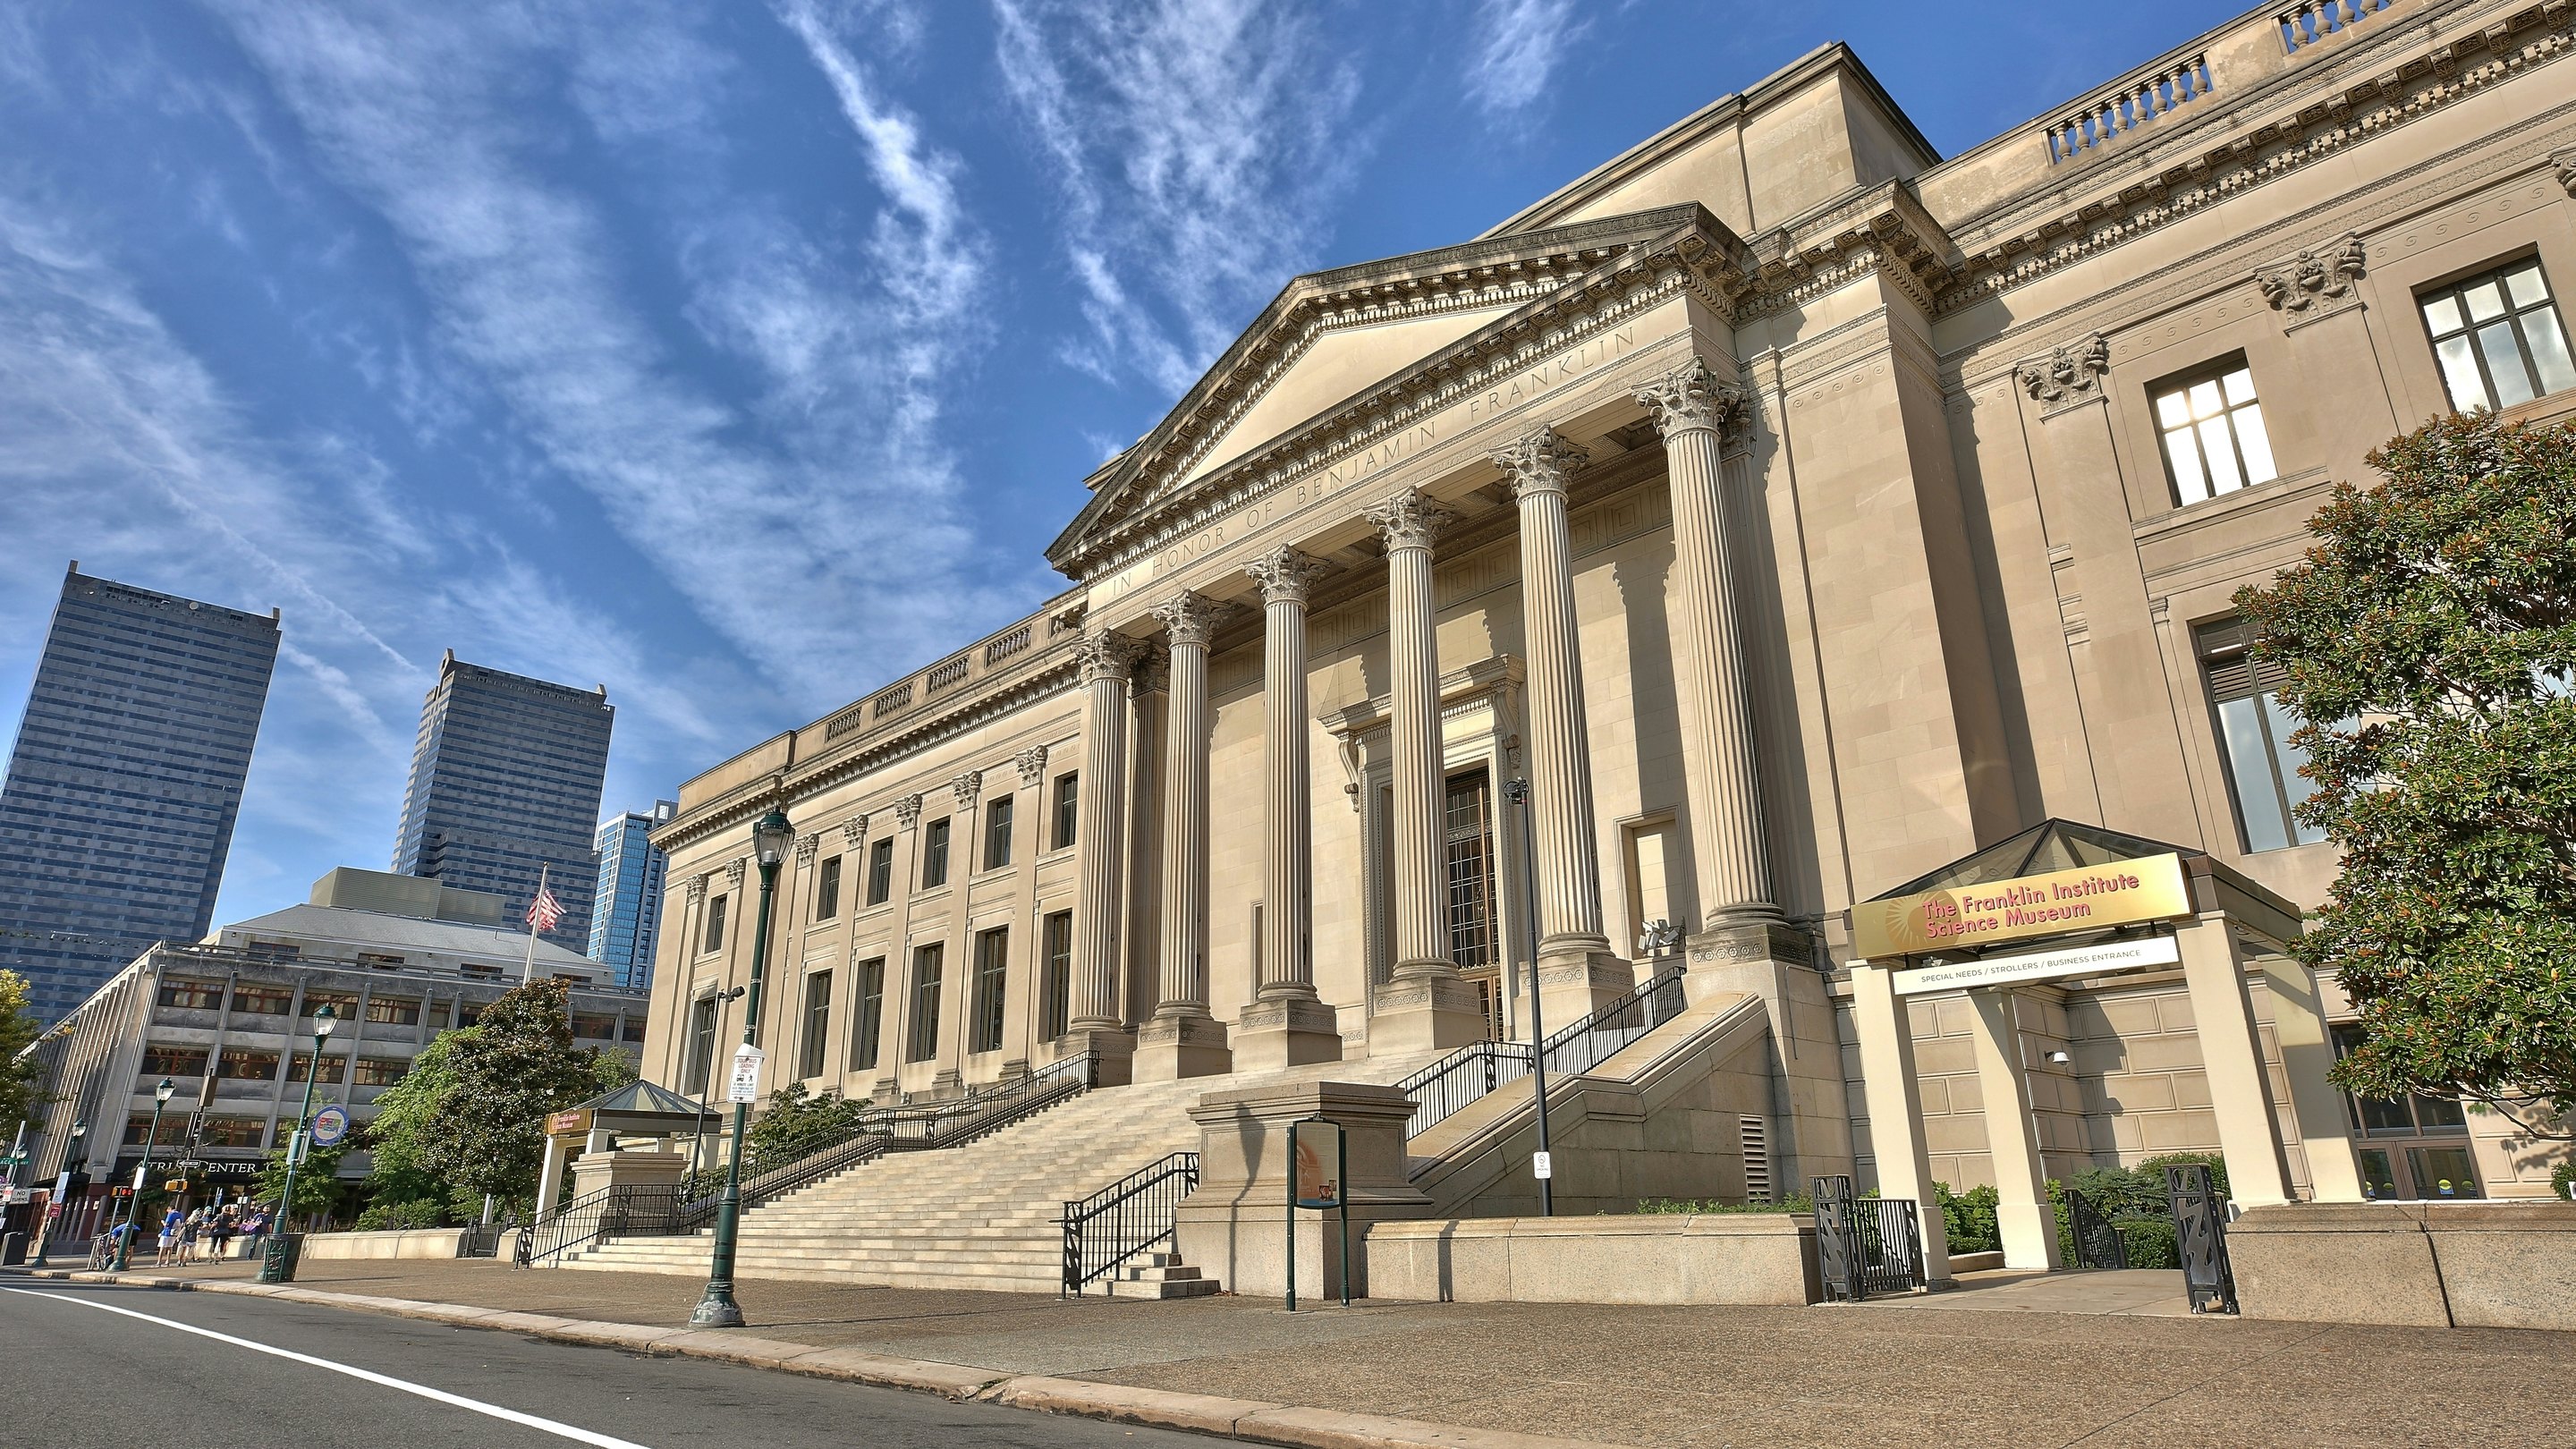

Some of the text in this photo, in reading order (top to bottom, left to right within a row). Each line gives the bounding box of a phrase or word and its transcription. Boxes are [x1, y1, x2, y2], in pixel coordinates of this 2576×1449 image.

[1112, 326, 1636, 596] IN HONOR OF BENJAMIN FRANKLIN
[1922, 873, 2140, 919] The Franklin Institute
[1926, 902, 2091, 938] Science Museum
[1920, 972, 1954, 983] SPECIAL
[1955, 969, 1983, 979] NEEDS
[1990, 962, 2039, 974] STROLLERS
[2046, 955, 2090, 967] BUSINESS
[2092, 949, 2141, 961] ENTRANCE
